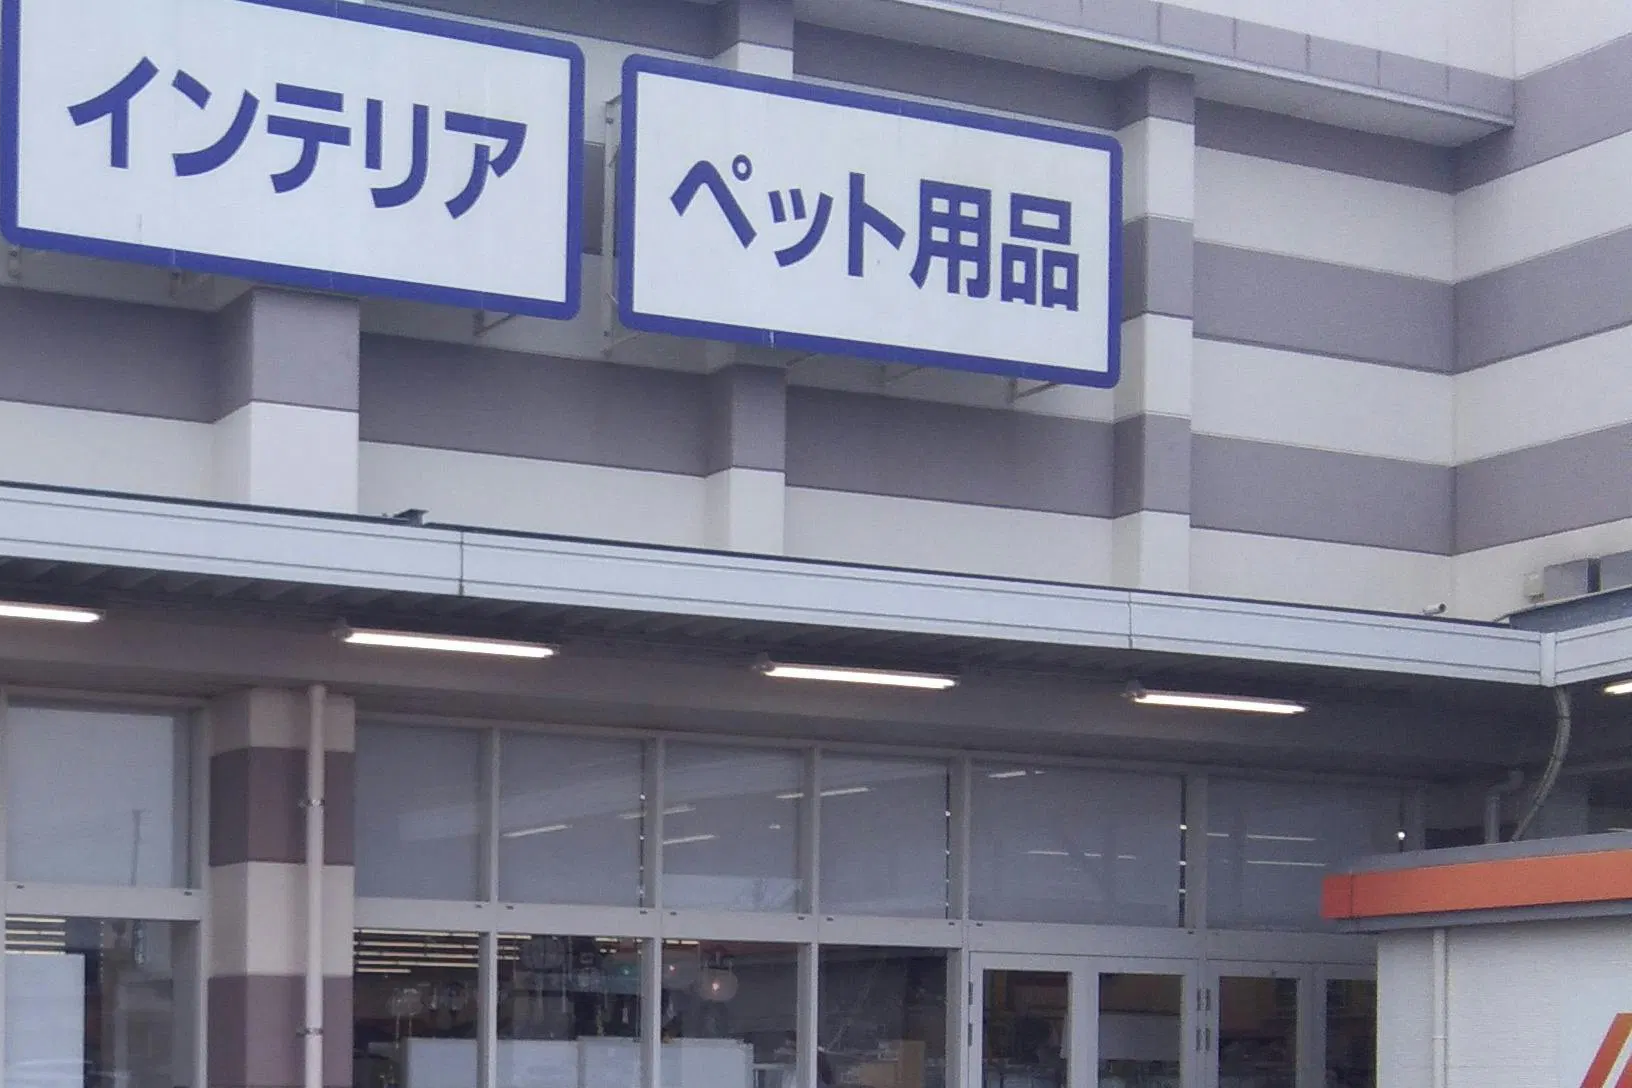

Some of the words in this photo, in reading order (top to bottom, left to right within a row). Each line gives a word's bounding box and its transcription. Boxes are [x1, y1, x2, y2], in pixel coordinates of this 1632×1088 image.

[68, 56, 527, 219] インテリア
[670, 153, 1079, 312] ペット用品
